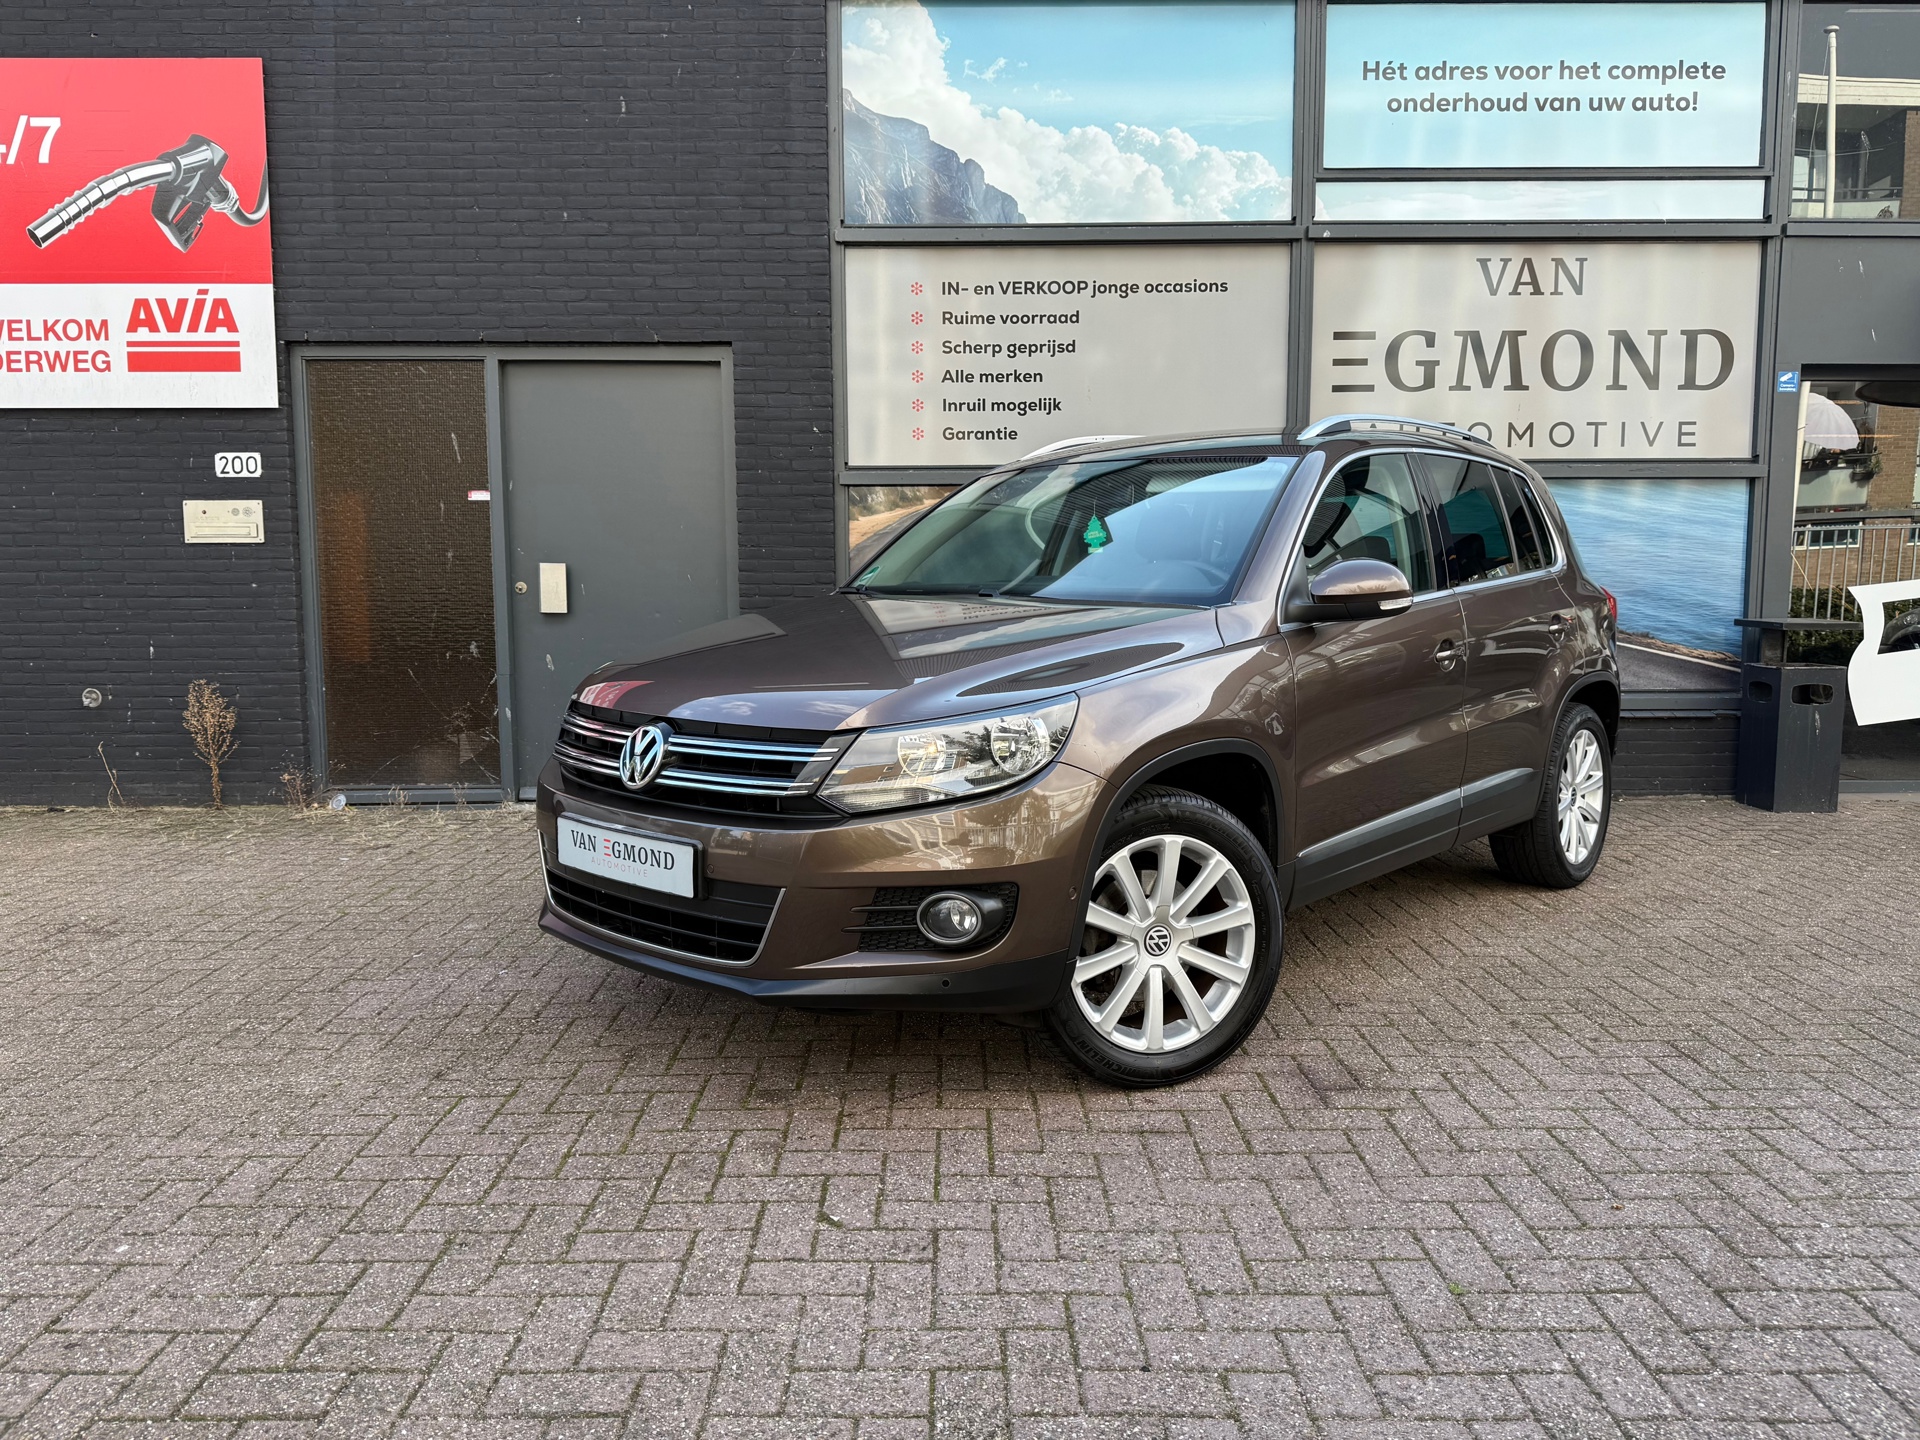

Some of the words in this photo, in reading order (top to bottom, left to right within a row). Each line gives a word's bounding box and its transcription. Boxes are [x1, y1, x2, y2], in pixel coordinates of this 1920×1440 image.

[1362, 60, 1408, 81] Hét
[1415, 60, 1489, 81] adres
[1494, 65, 1553, 81] voor
[1559, 60, 1601, 80] het
[1607, 60, 1727, 86] complete
[1387, 92, 1528, 113] onderhoud
[1534, 97, 1581, 112] van
[1588, 97, 1626, 112] uw
[1631, 91, 1699, 112] auto!
[0, 114, 62, 165] /7
[1476, 257, 1588, 296] VAN
[942, 281, 969, 296] IN-
[974, 284, 994, 296] en
[999, 280, 1089, 296] VERKOOP
[1091, 281, 1140, 299] jonge
[1144, 279, 1229, 294] occasions
[942, 311, 996, 325] Ruime
[1000, 310, 1080, 325] voorraad
[0, 318, 110, 342] ELKOM
[942, 341, 1003, 357] Scherp
[1006, 340, 1076, 358] geprijsd
[0, 349, 111, 373] ERWEG
[1331, 328, 1735, 393] EGMOND
[942, 370, 975, 383] Alle
[979, 369, 1043, 383] merken
[942, 398, 986, 412] Inruil
[990, 397, 1062, 416] mogelijk
[942, 426, 1018, 441] Garantie
[219, 455, 258, 475] 200
[571, 829, 597, 853] VAN
[603, 838, 676, 871] EGMOND
[591, 856, 649, 878] AUTOMOTIVE
